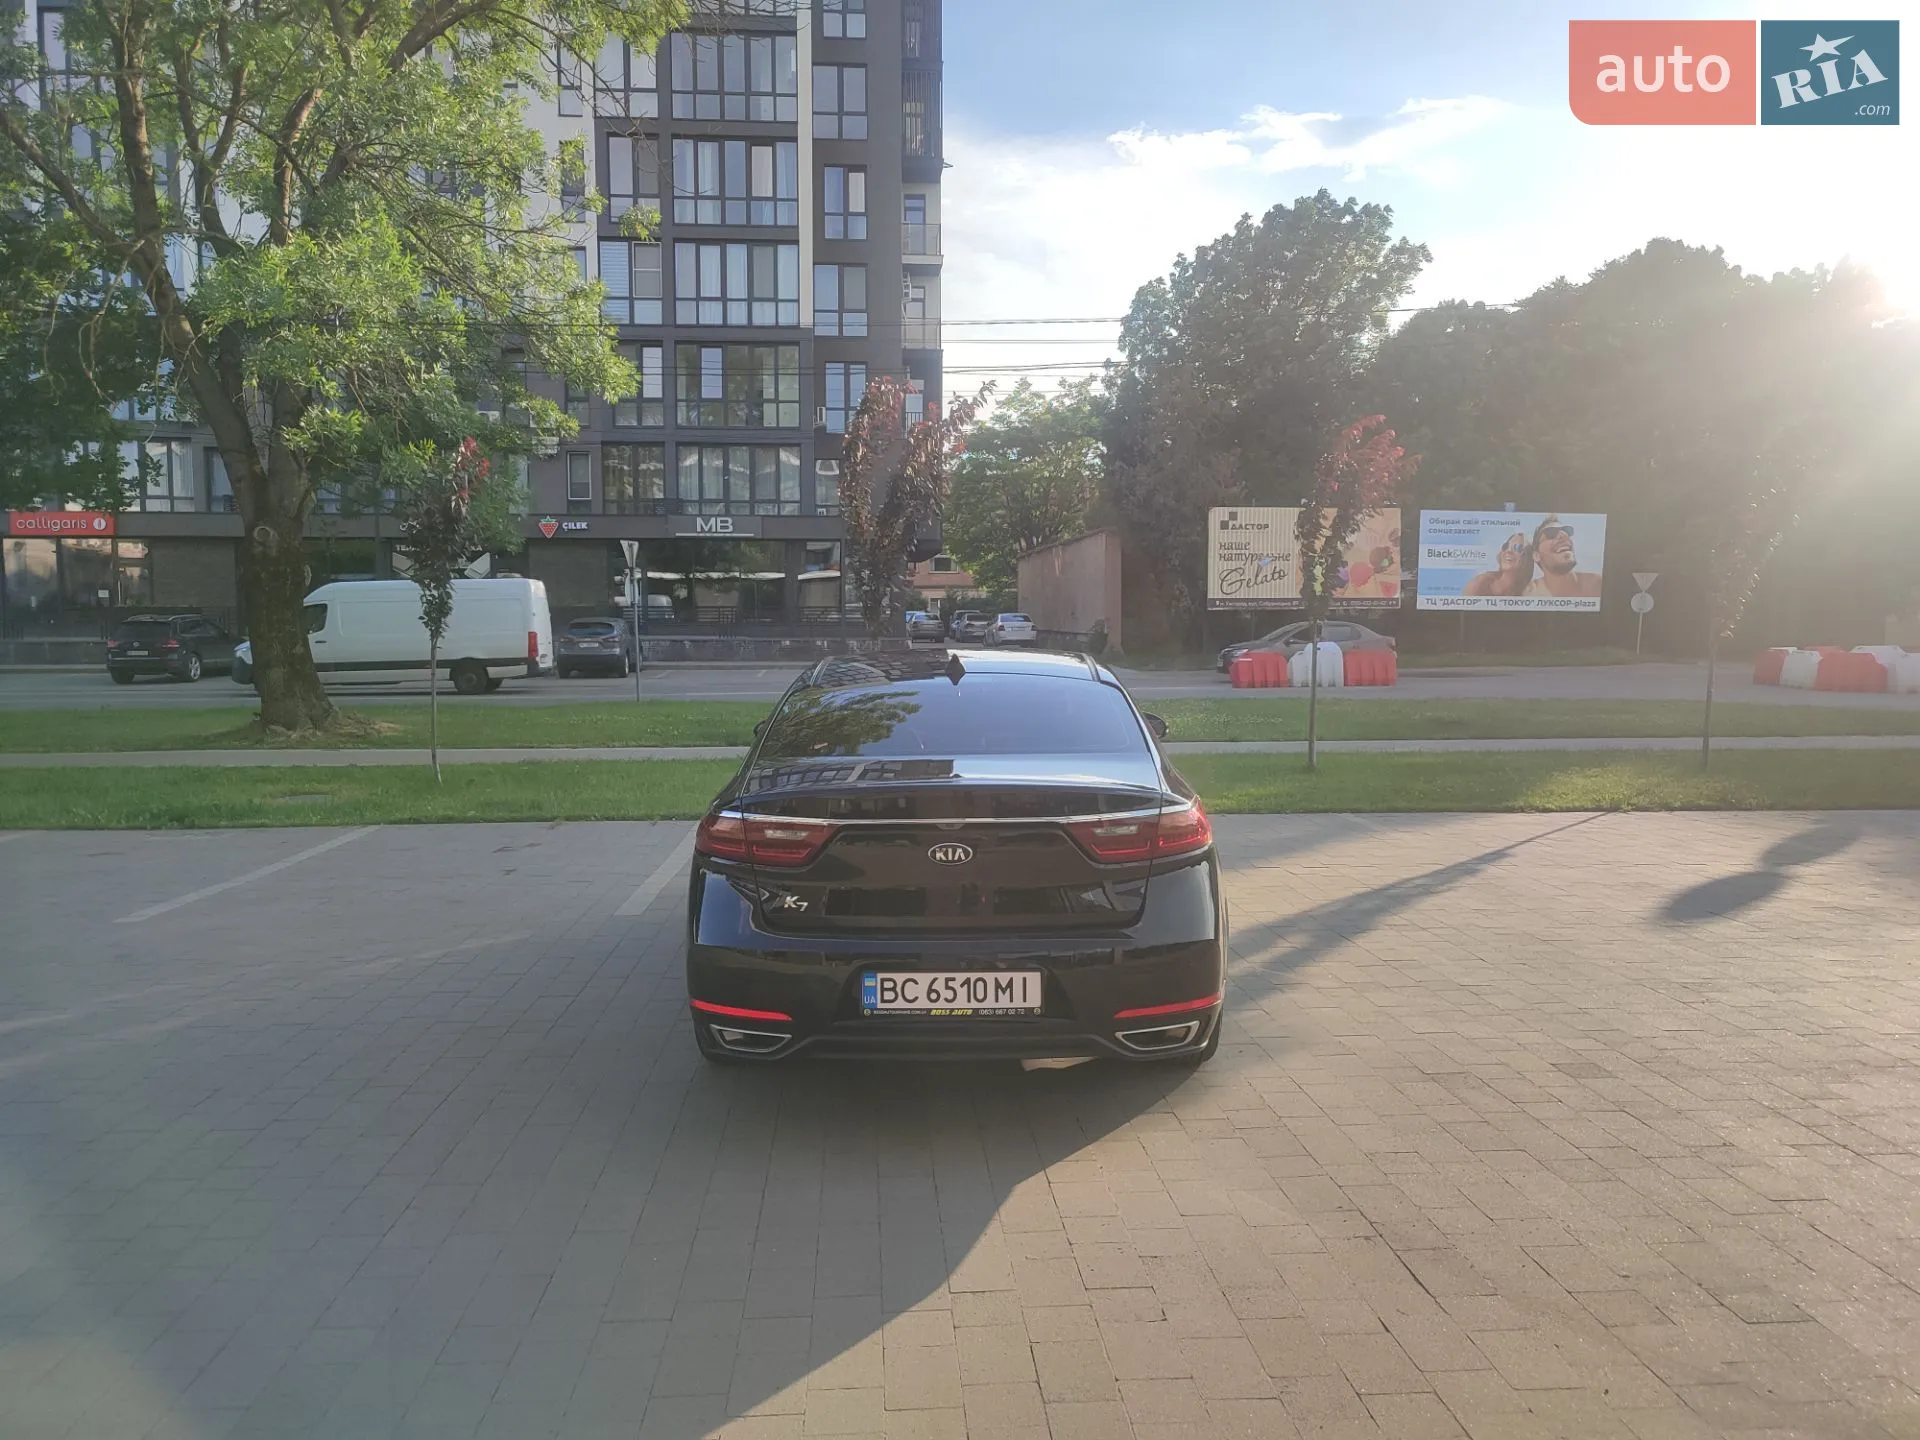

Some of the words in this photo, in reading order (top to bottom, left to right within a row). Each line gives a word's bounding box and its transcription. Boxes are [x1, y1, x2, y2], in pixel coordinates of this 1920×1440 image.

[16, 517, 87, 532] calligaris
[562, 521, 589, 532] ÇILEK
[696, 516, 734, 533] MB
[1219, 541, 1251, 551] наше
[1218, 566, 1288, 596] Gelato
[1425, 598, 1437, 607] ТЦ
[1486, 599, 1497, 608] ТЦ
[935, 847, 966, 861] KIA
[783, 895, 809, 912] K7
[880, 977, 919, 1004] BC
[926, 976, 988, 1004] 6510
[994, 976, 1027, 1003] MI
[864, 995, 876, 1004] UA
[951, 1008, 973, 1016] AUTO
